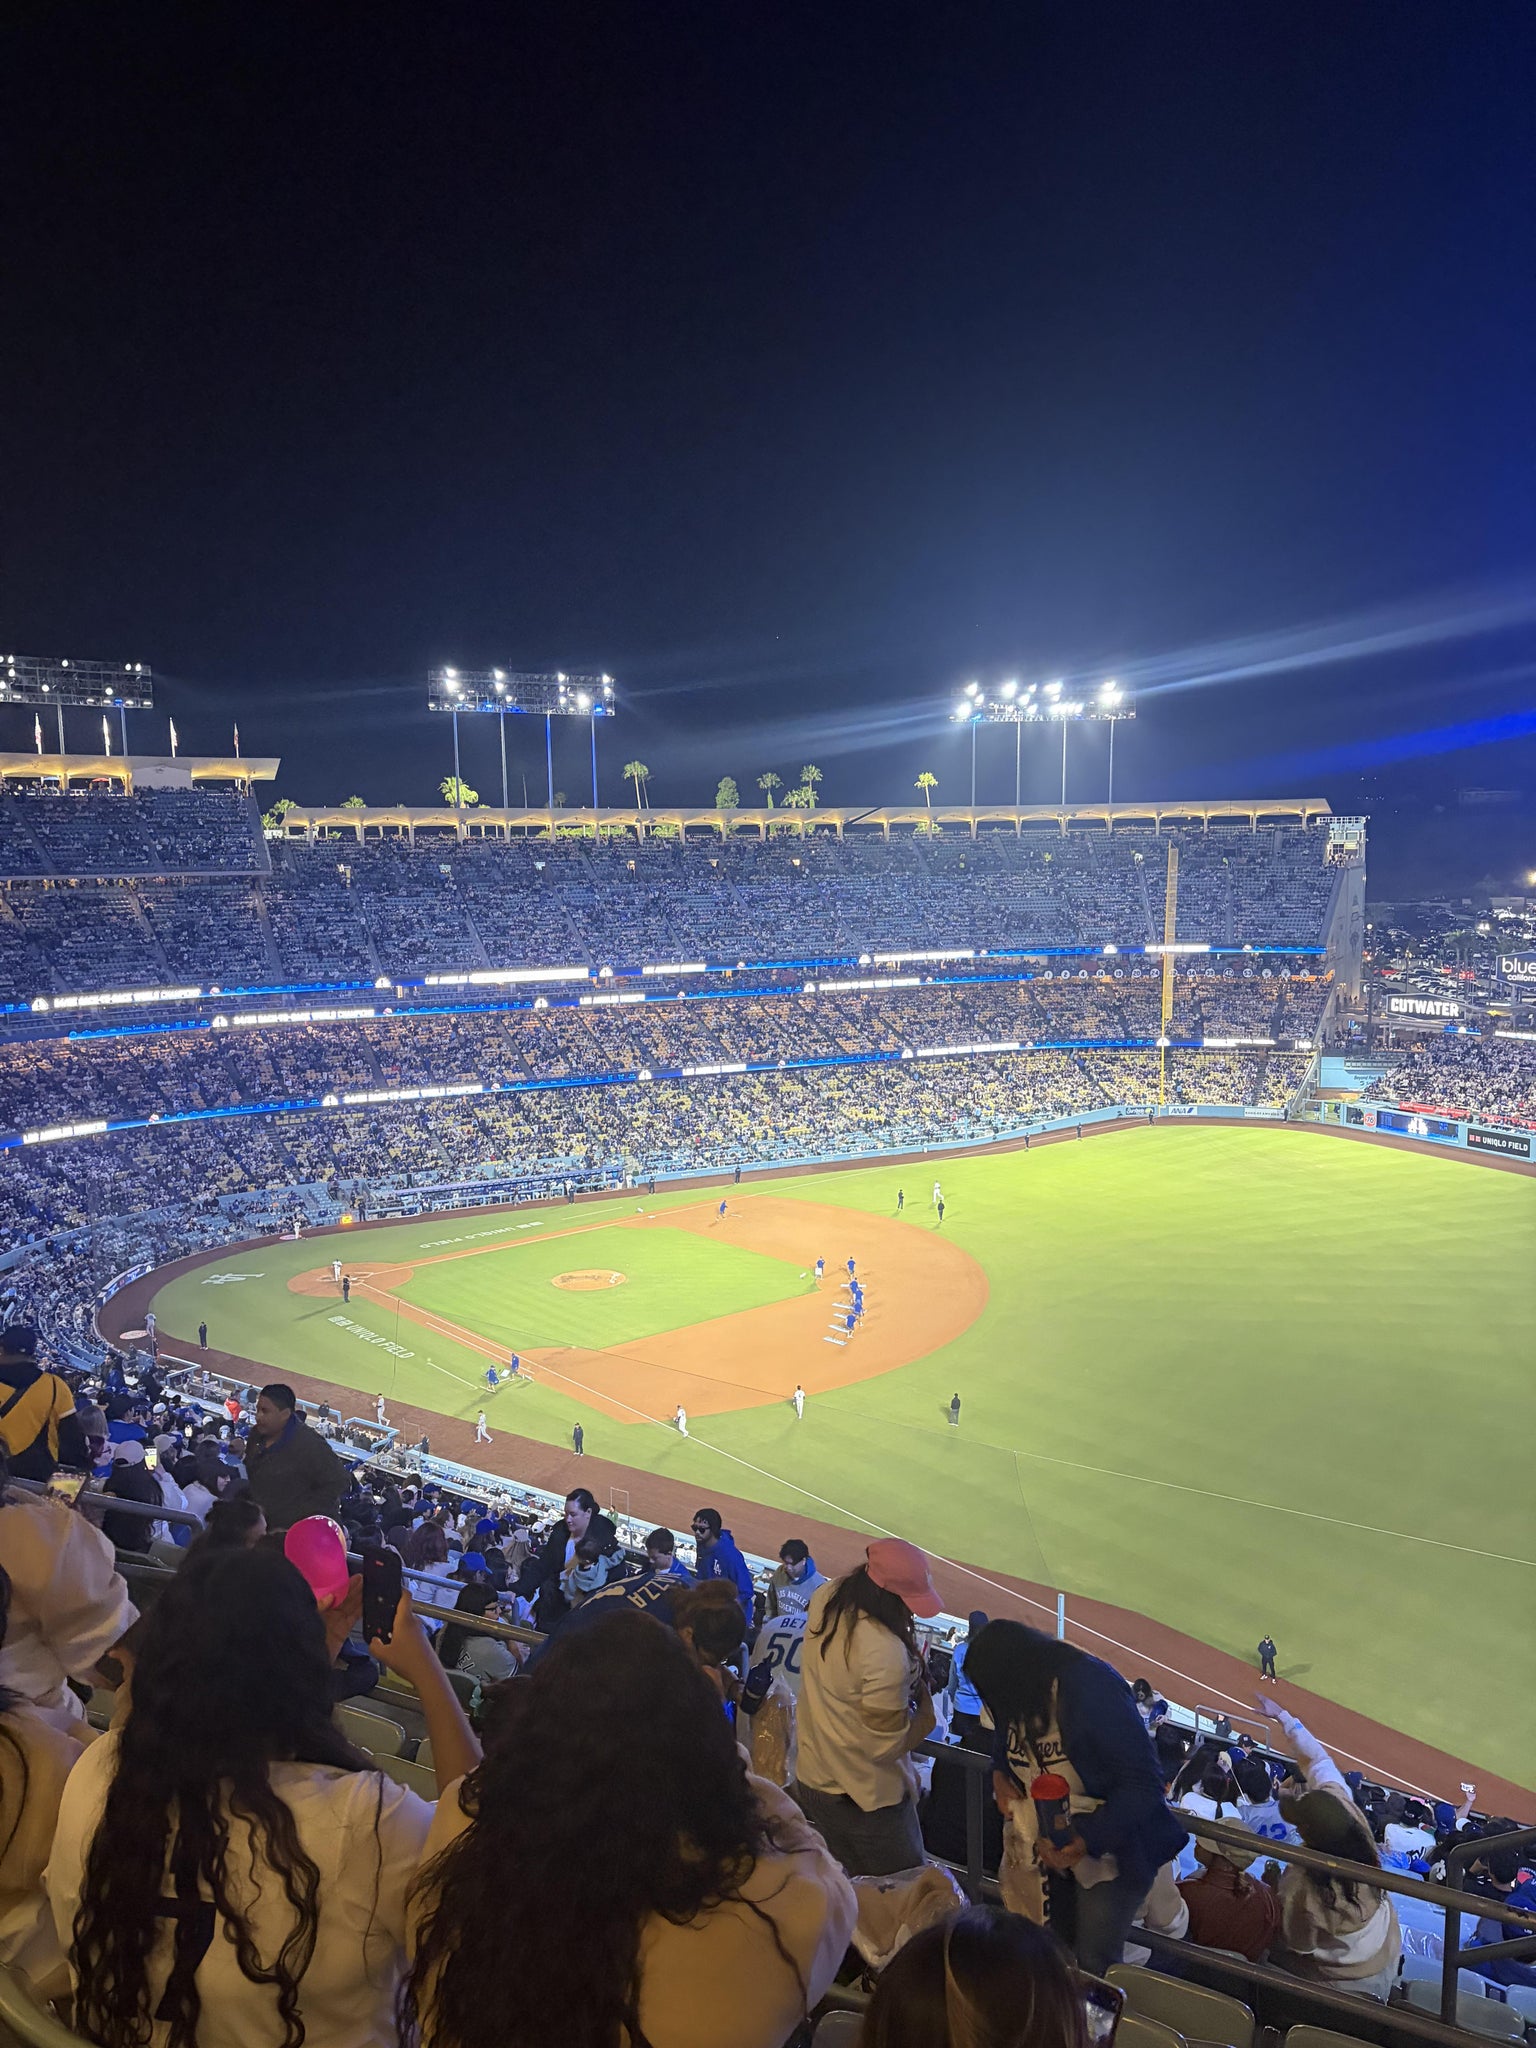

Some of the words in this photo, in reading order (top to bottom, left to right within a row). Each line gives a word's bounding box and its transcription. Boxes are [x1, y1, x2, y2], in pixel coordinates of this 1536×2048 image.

[1502, 957, 1536, 974] blue
[1391, 998, 1459, 1017] CUTWATER
[1482, 1136, 1507, 1147] UNIQLO
[1508, 1141, 1529, 1151] FIELD
[346, 1324, 387, 1344] UNIQLO
[377, 1341, 415, 1359] FIELD
